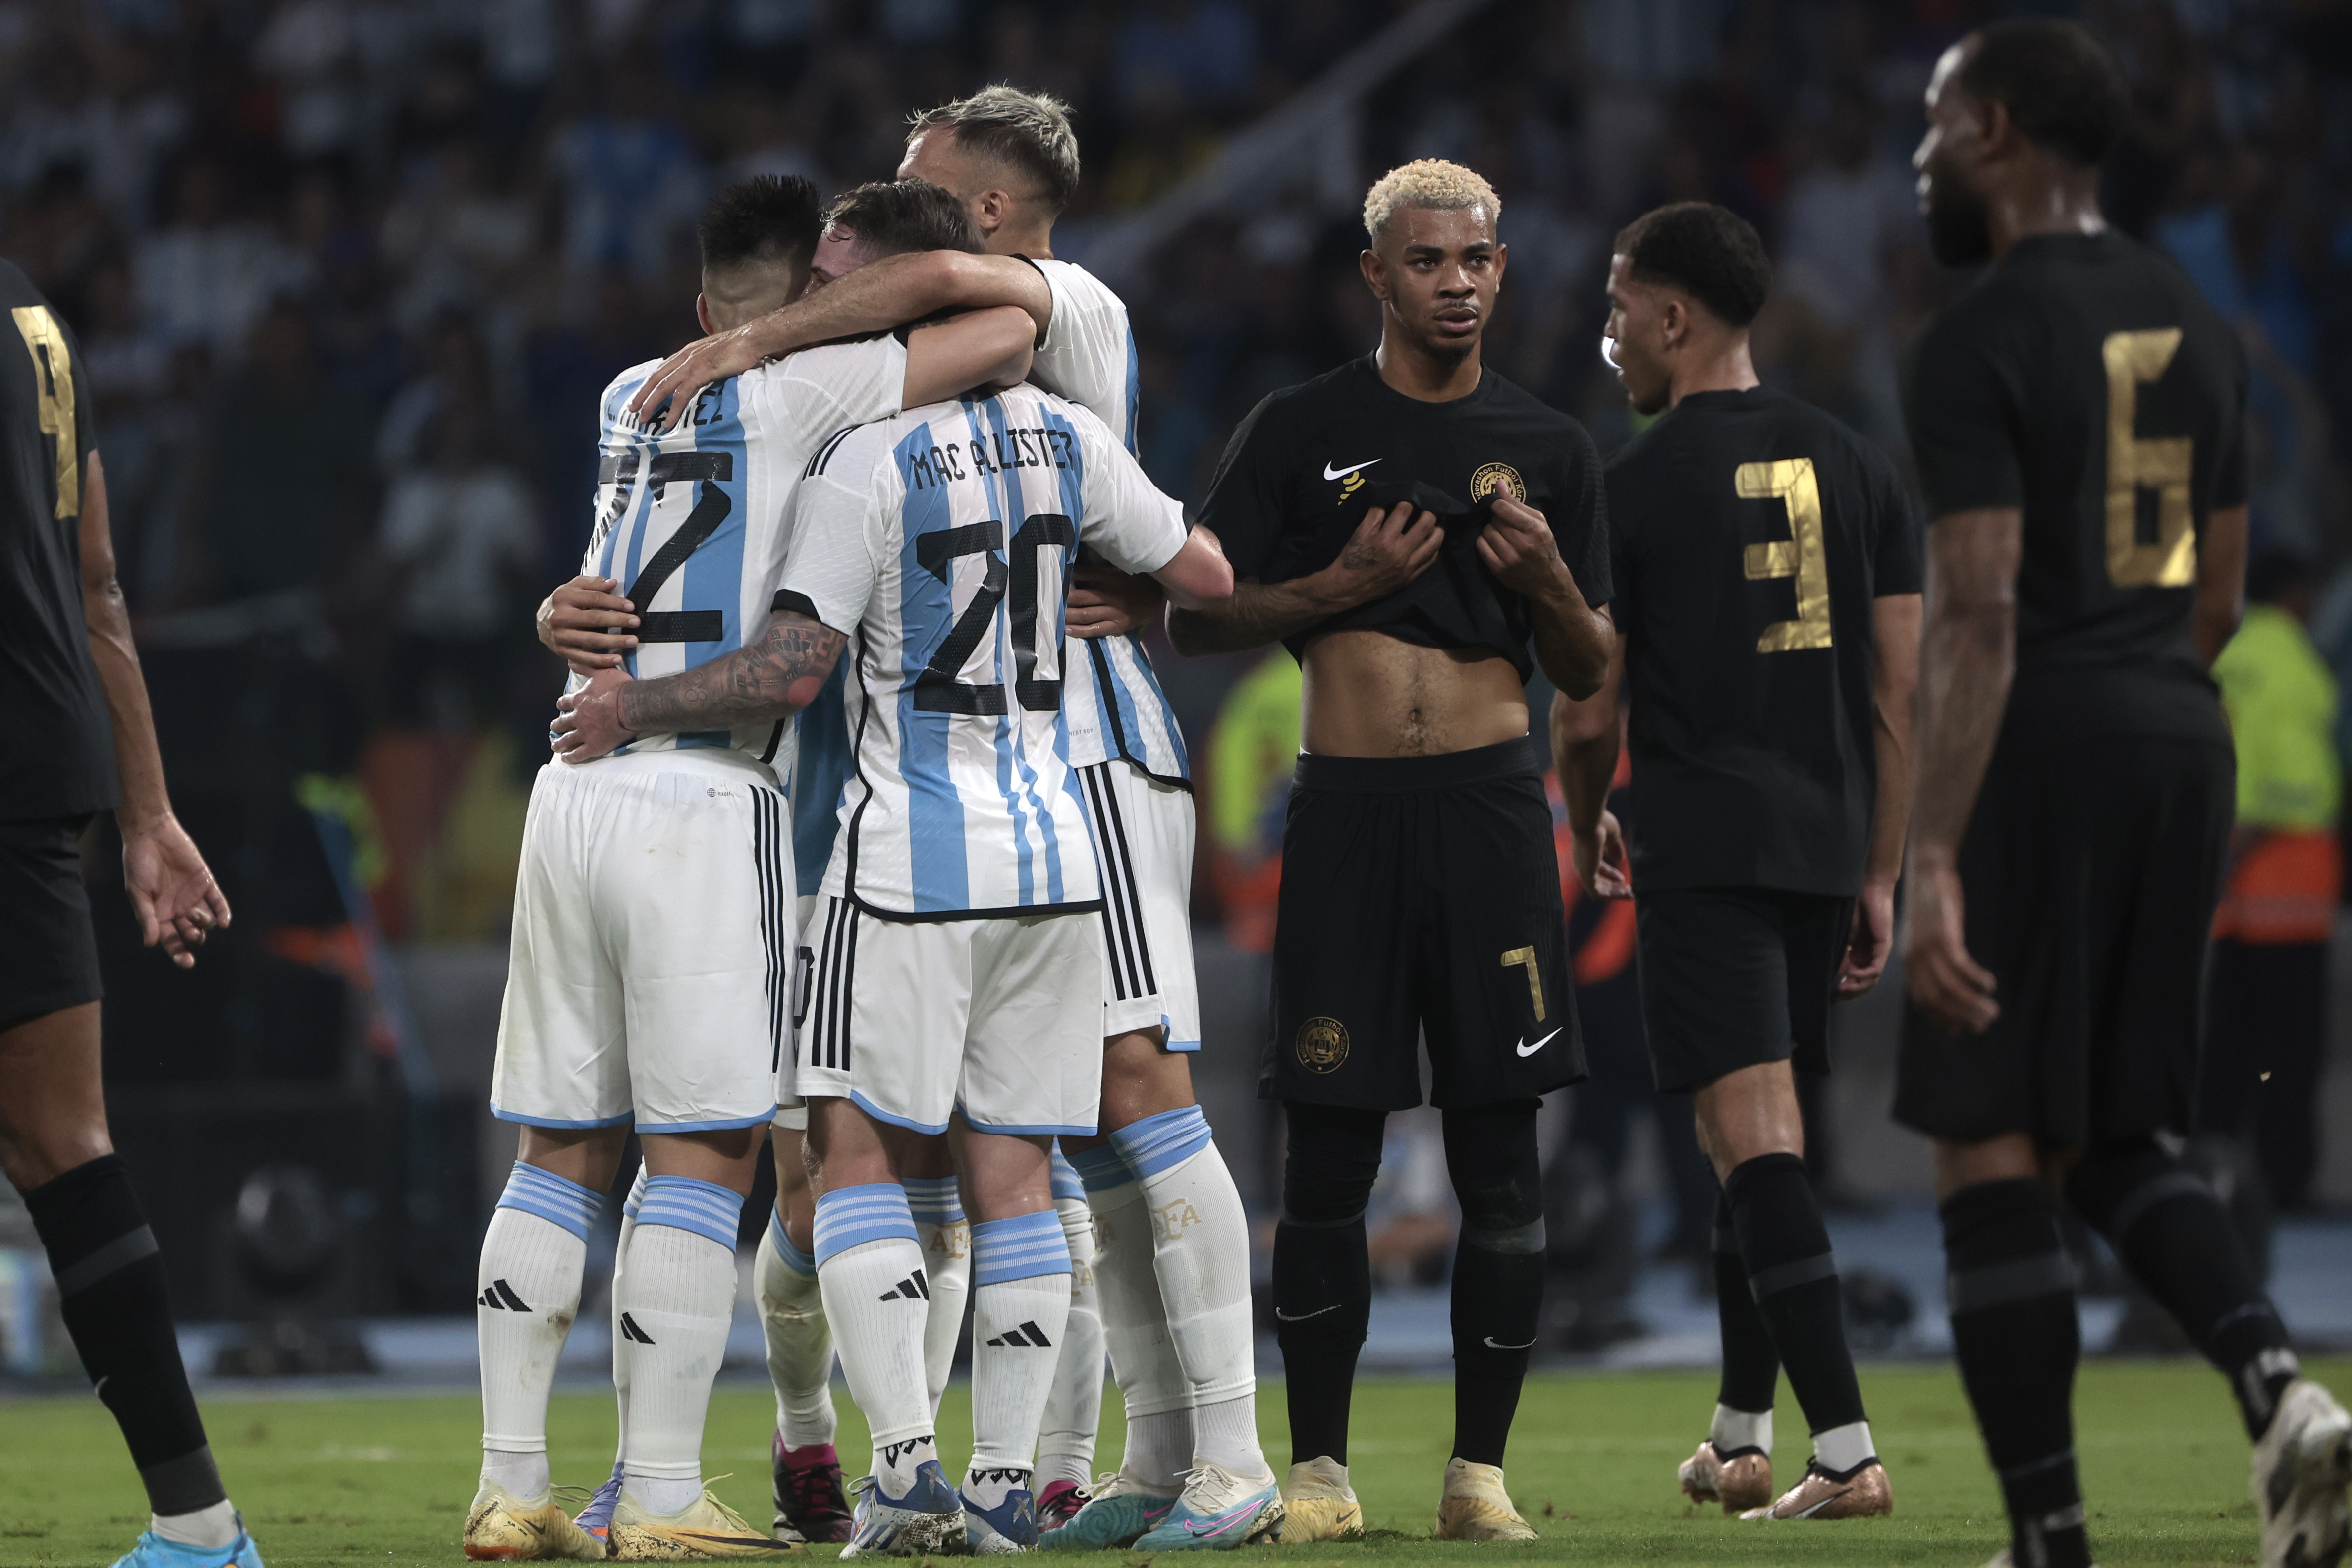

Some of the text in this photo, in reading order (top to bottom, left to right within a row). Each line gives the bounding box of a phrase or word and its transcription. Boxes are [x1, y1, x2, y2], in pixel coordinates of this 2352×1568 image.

[11, 305, 78, 520] 9
[910, 428, 1072, 490] MAC ALLISTER
[1475, 467, 1493, 500] derashon
[2102, 327, 2196, 589] 6
[580, 451, 733, 643] 22
[913, 513, 1075, 715] 20
[1735, 457, 1832, 653] 3
[1501, 945, 1545, 1022] 7
